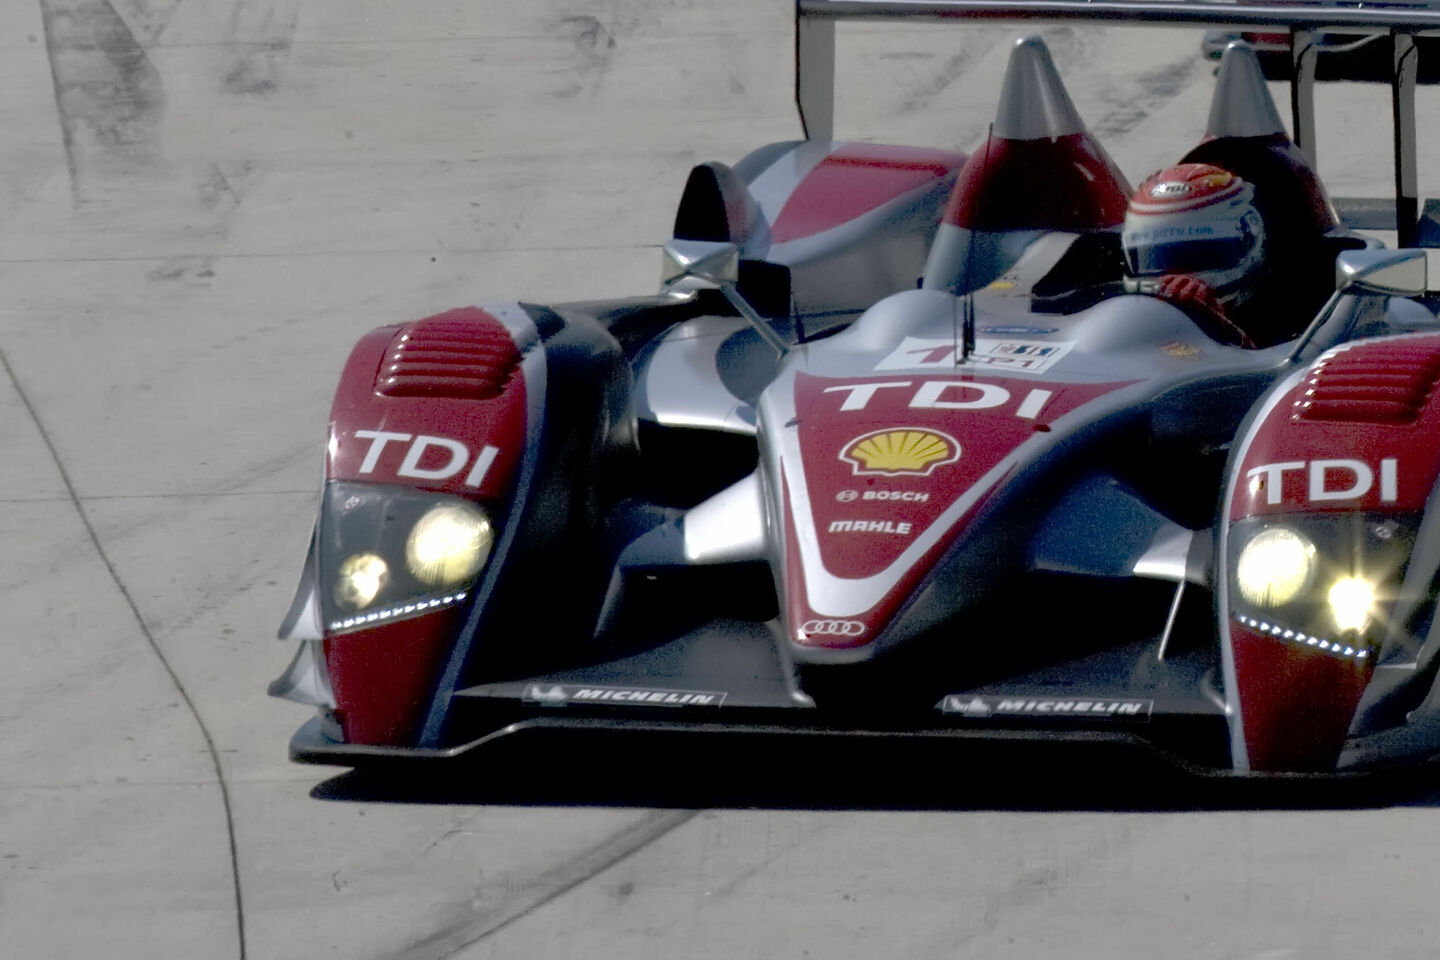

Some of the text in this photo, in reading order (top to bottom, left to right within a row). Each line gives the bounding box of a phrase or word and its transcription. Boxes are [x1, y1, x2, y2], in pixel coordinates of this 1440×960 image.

[906, 345, 958, 364] 1
[823, 380, 1053, 419] TDI
[354, 428, 500, 487] TDI
[1249, 458, 1397, 505] TDI
[862, 490, 930, 503] BOSCH
[828, 520, 912, 535] MAHLE
[573, 689, 715, 704] MICHELIN
[998, 699, 1143, 715] MICHELIN
